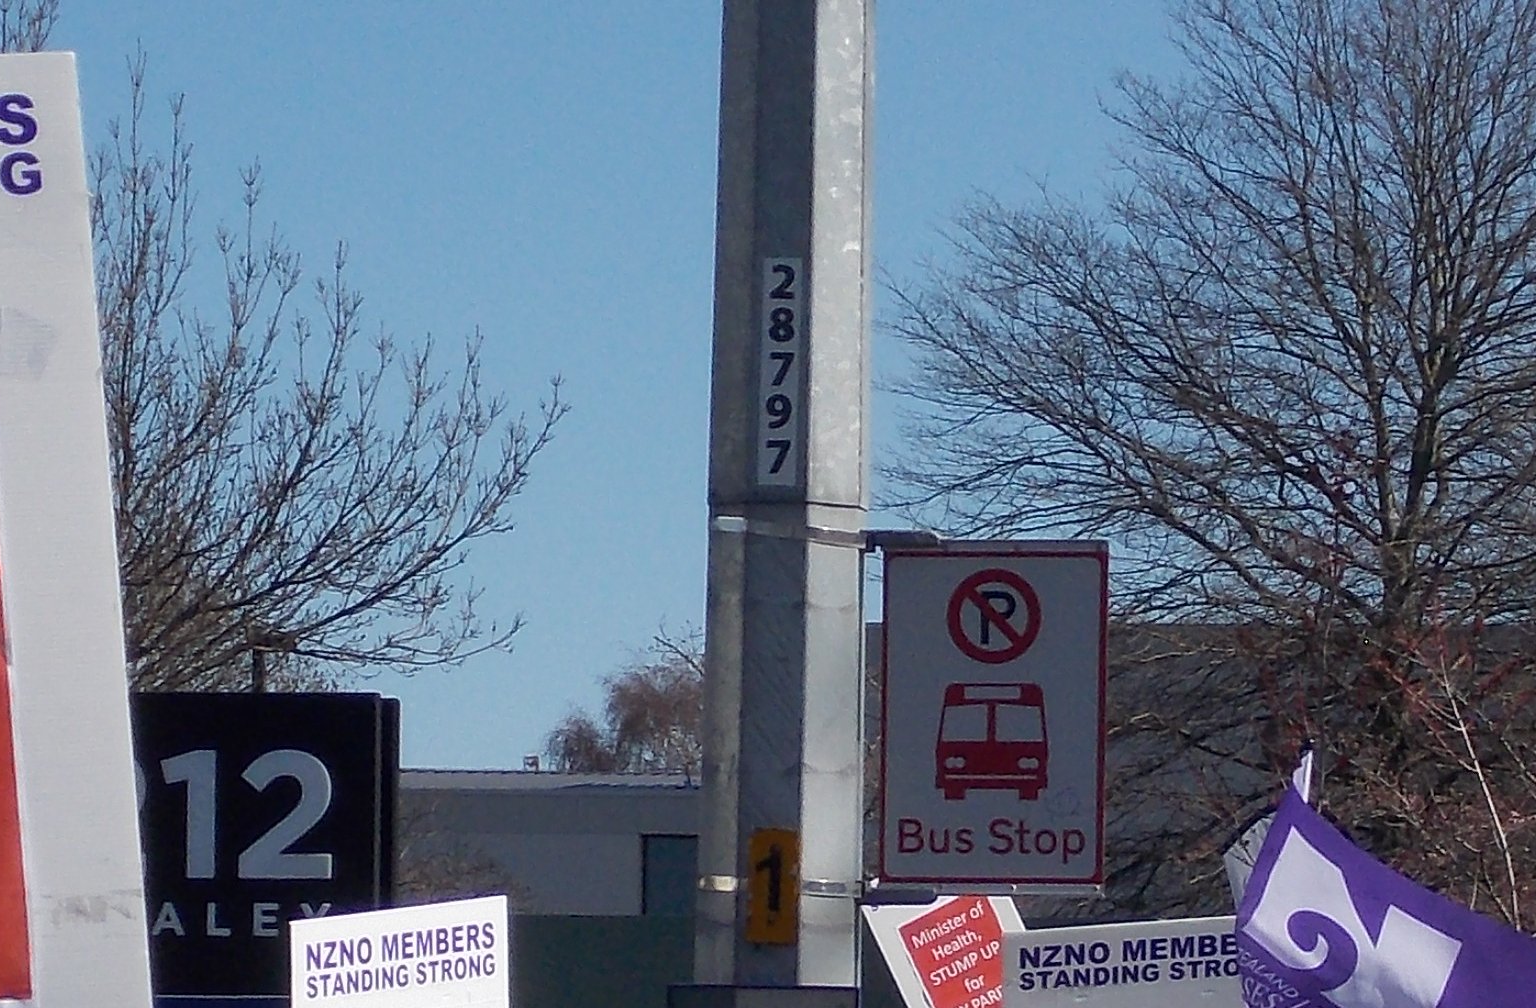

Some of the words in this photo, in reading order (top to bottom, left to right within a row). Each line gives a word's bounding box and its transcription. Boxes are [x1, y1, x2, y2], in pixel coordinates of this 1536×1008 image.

[765, 264, 795, 474] 28797
[898, 818, 974, 854] Bus
[988, 818, 1086, 865] Stop
[754, 843, 781, 912] 1
[306, 937, 372, 972] NZNO
[381, 922, 495, 962] MEMBERS
[912, 912, 967, 949] Minister
[970, 900, 985, 919] of
[931, 930, 982, 961] Health,
[930, 952, 979, 986] STUMP
[981, 941, 1000, 960] UP
[1019, 942, 1110, 970] NZNO
[1122, 933, 1238, 962] MEMBE
[1019, 963, 1159, 990] STANDING
[1169, 958, 1240, 981] STRO
[306, 964, 409, 999] STANDING
[416, 953, 495, 985] STRONG
[964, 975, 985, 993] for
